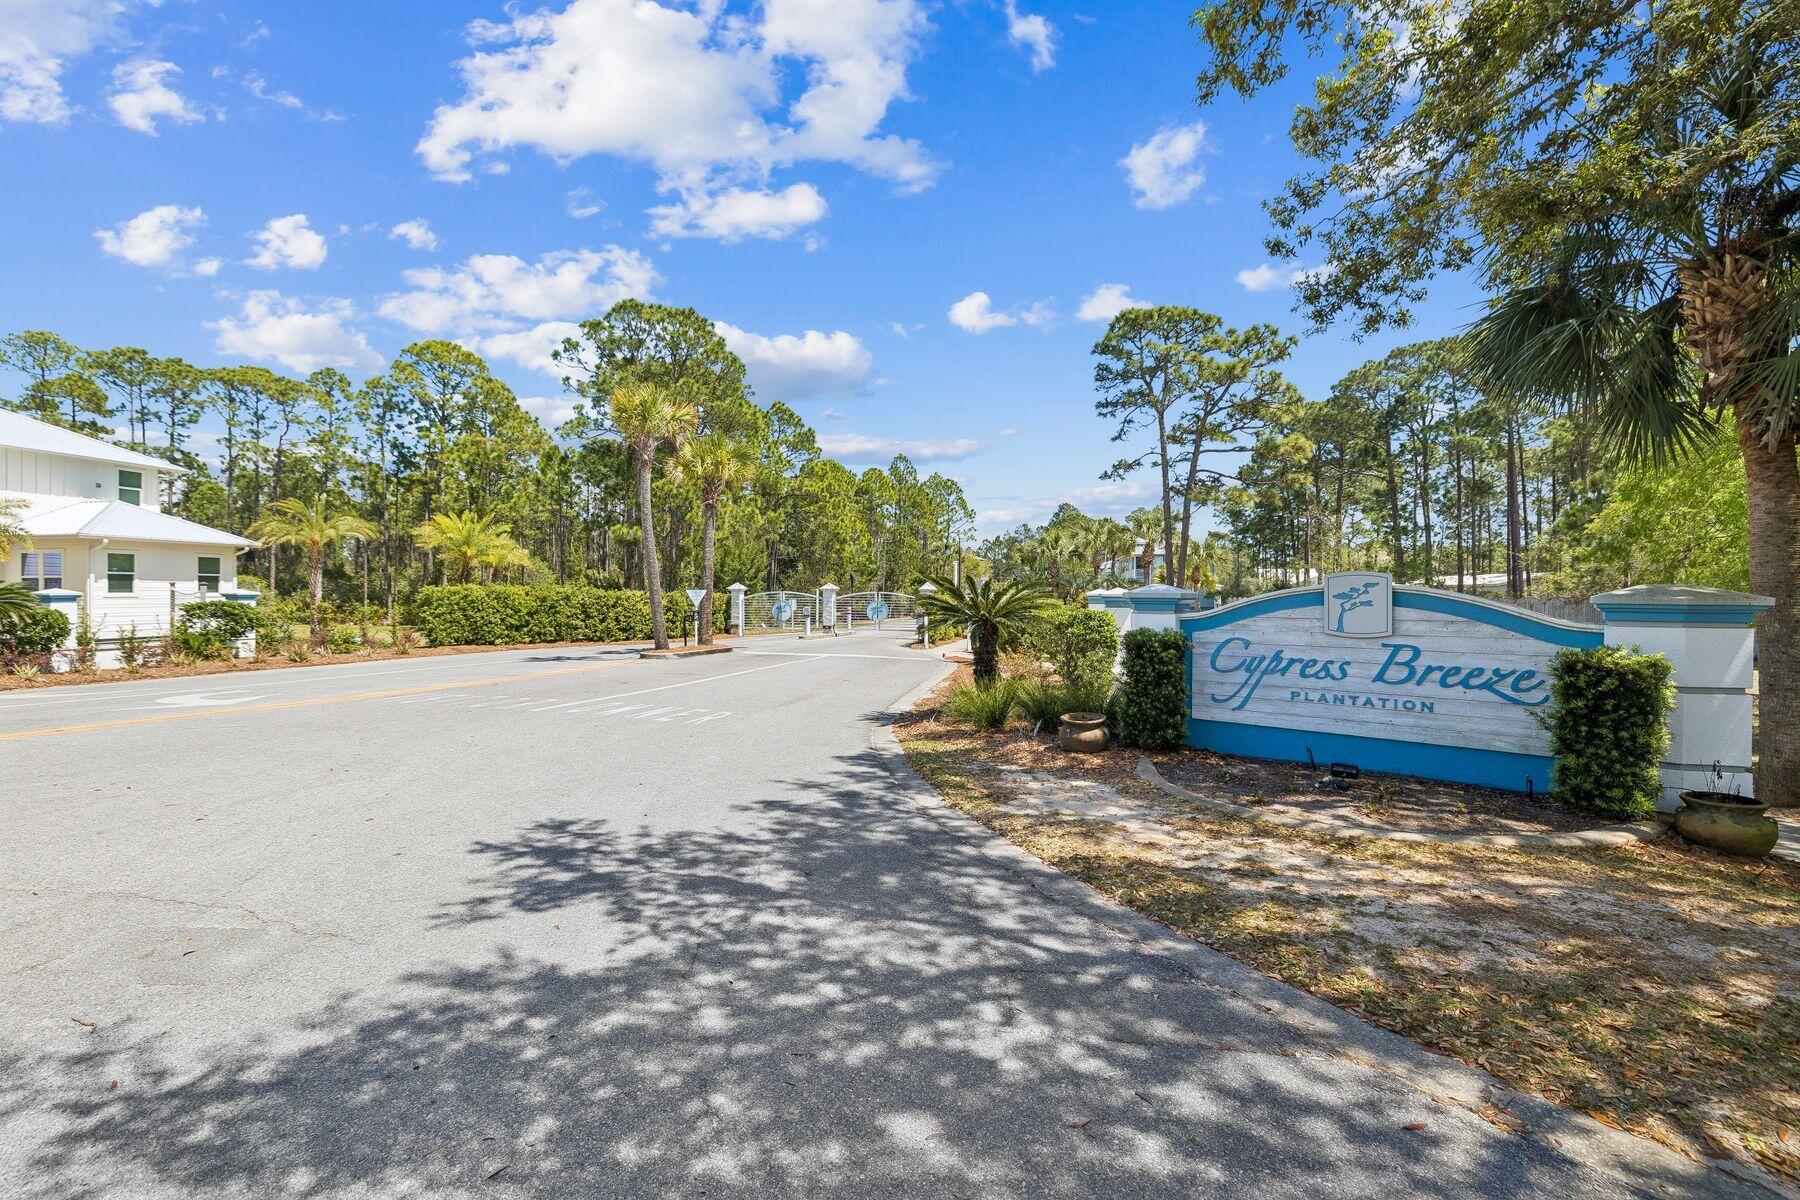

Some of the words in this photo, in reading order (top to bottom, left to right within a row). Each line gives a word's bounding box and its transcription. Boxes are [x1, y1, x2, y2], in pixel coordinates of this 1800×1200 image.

[1210, 638, 1350, 711] Cypress
[1371, 643, 1550, 707] Breeze
[1290, 690, 1435, 714] PLANTATION
